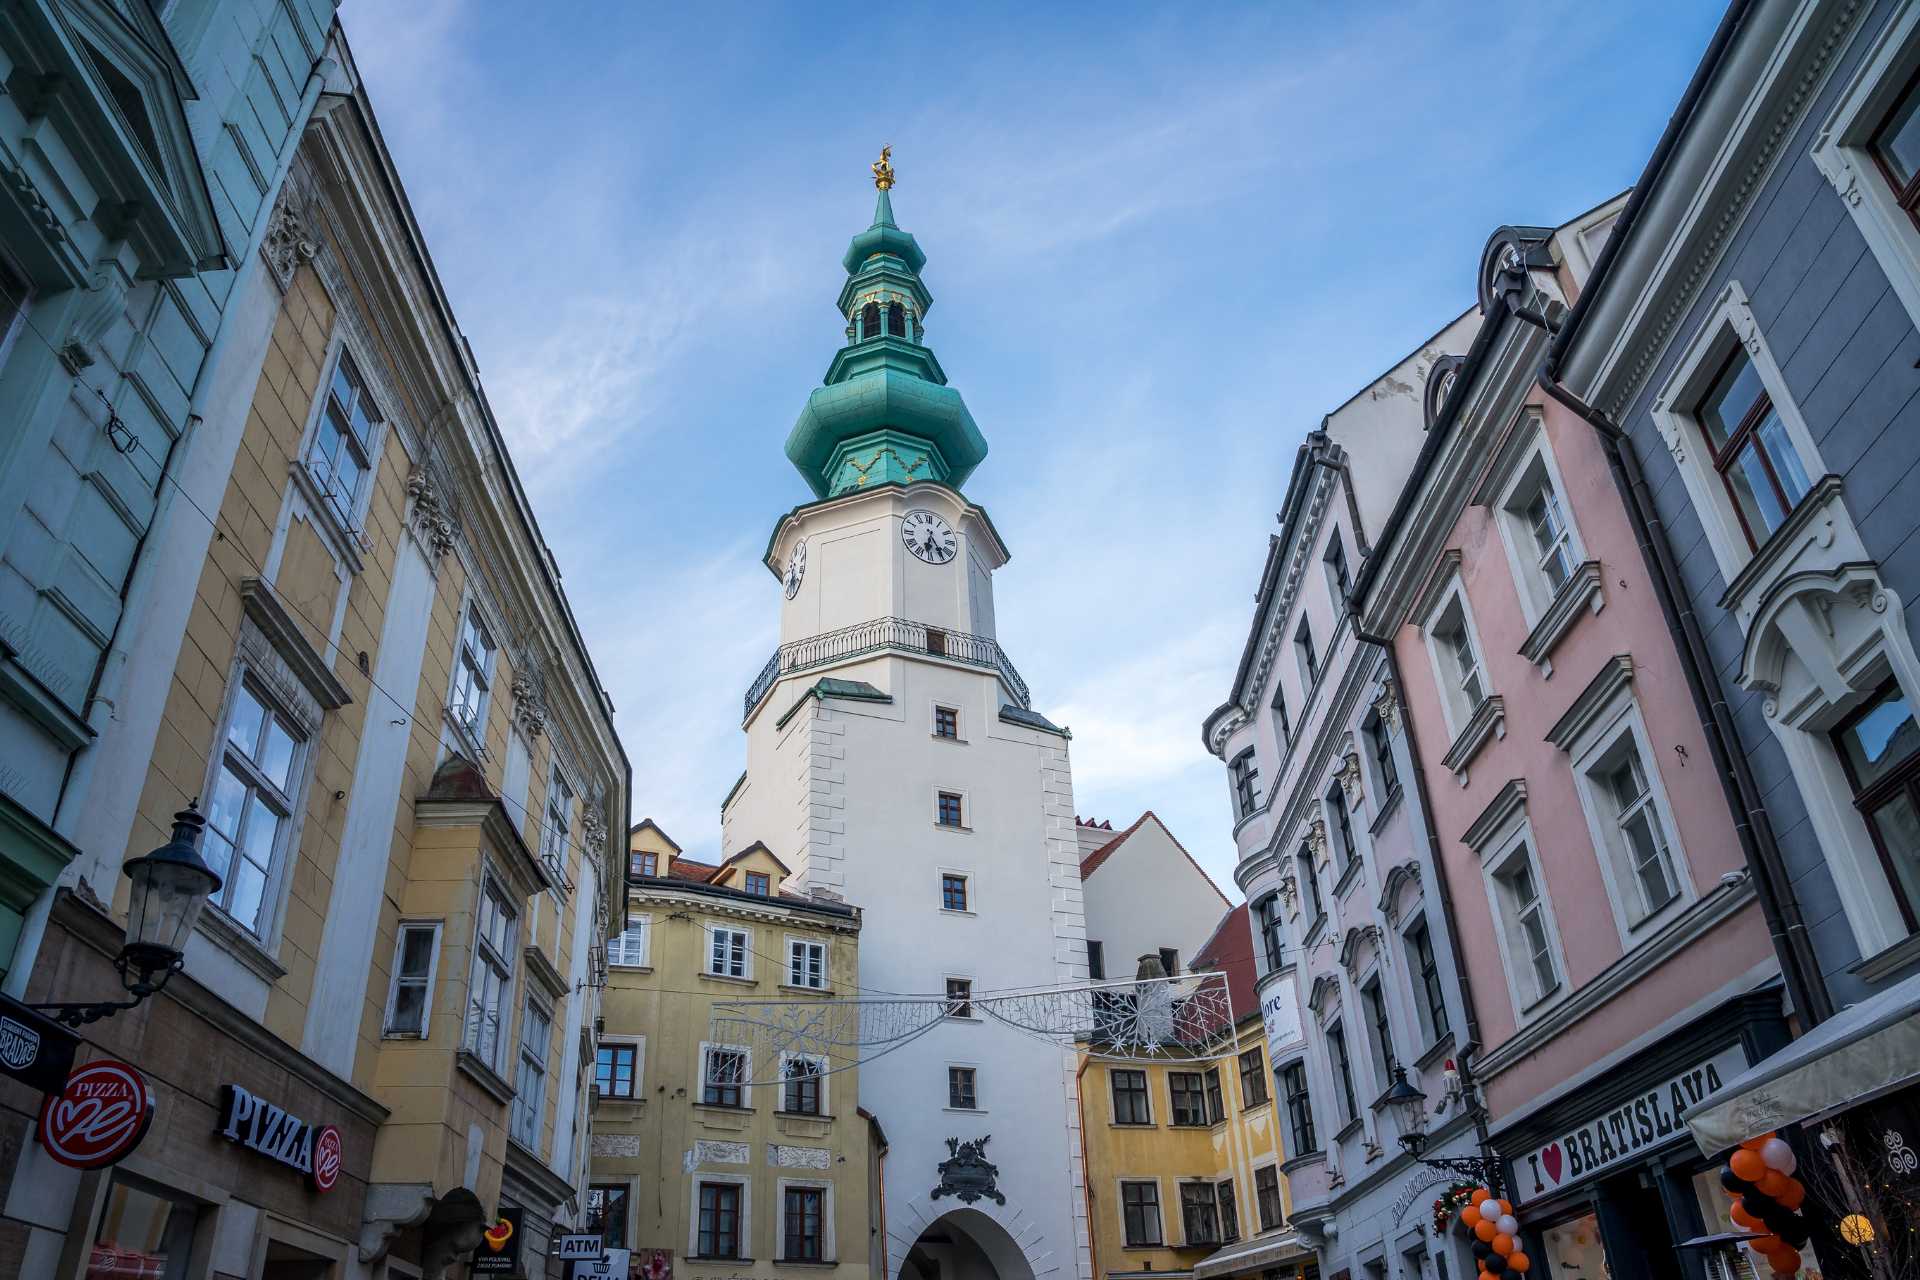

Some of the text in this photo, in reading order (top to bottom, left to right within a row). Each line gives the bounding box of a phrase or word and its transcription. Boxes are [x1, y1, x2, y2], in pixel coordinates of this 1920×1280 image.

[74, 1082, 129, 1097] PIZZA
[223, 1084, 313, 1173] PIZZA
[1528, 1063, 1722, 1193] I BRATISLAVA
[564, 1240, 599, 1252] ATM
